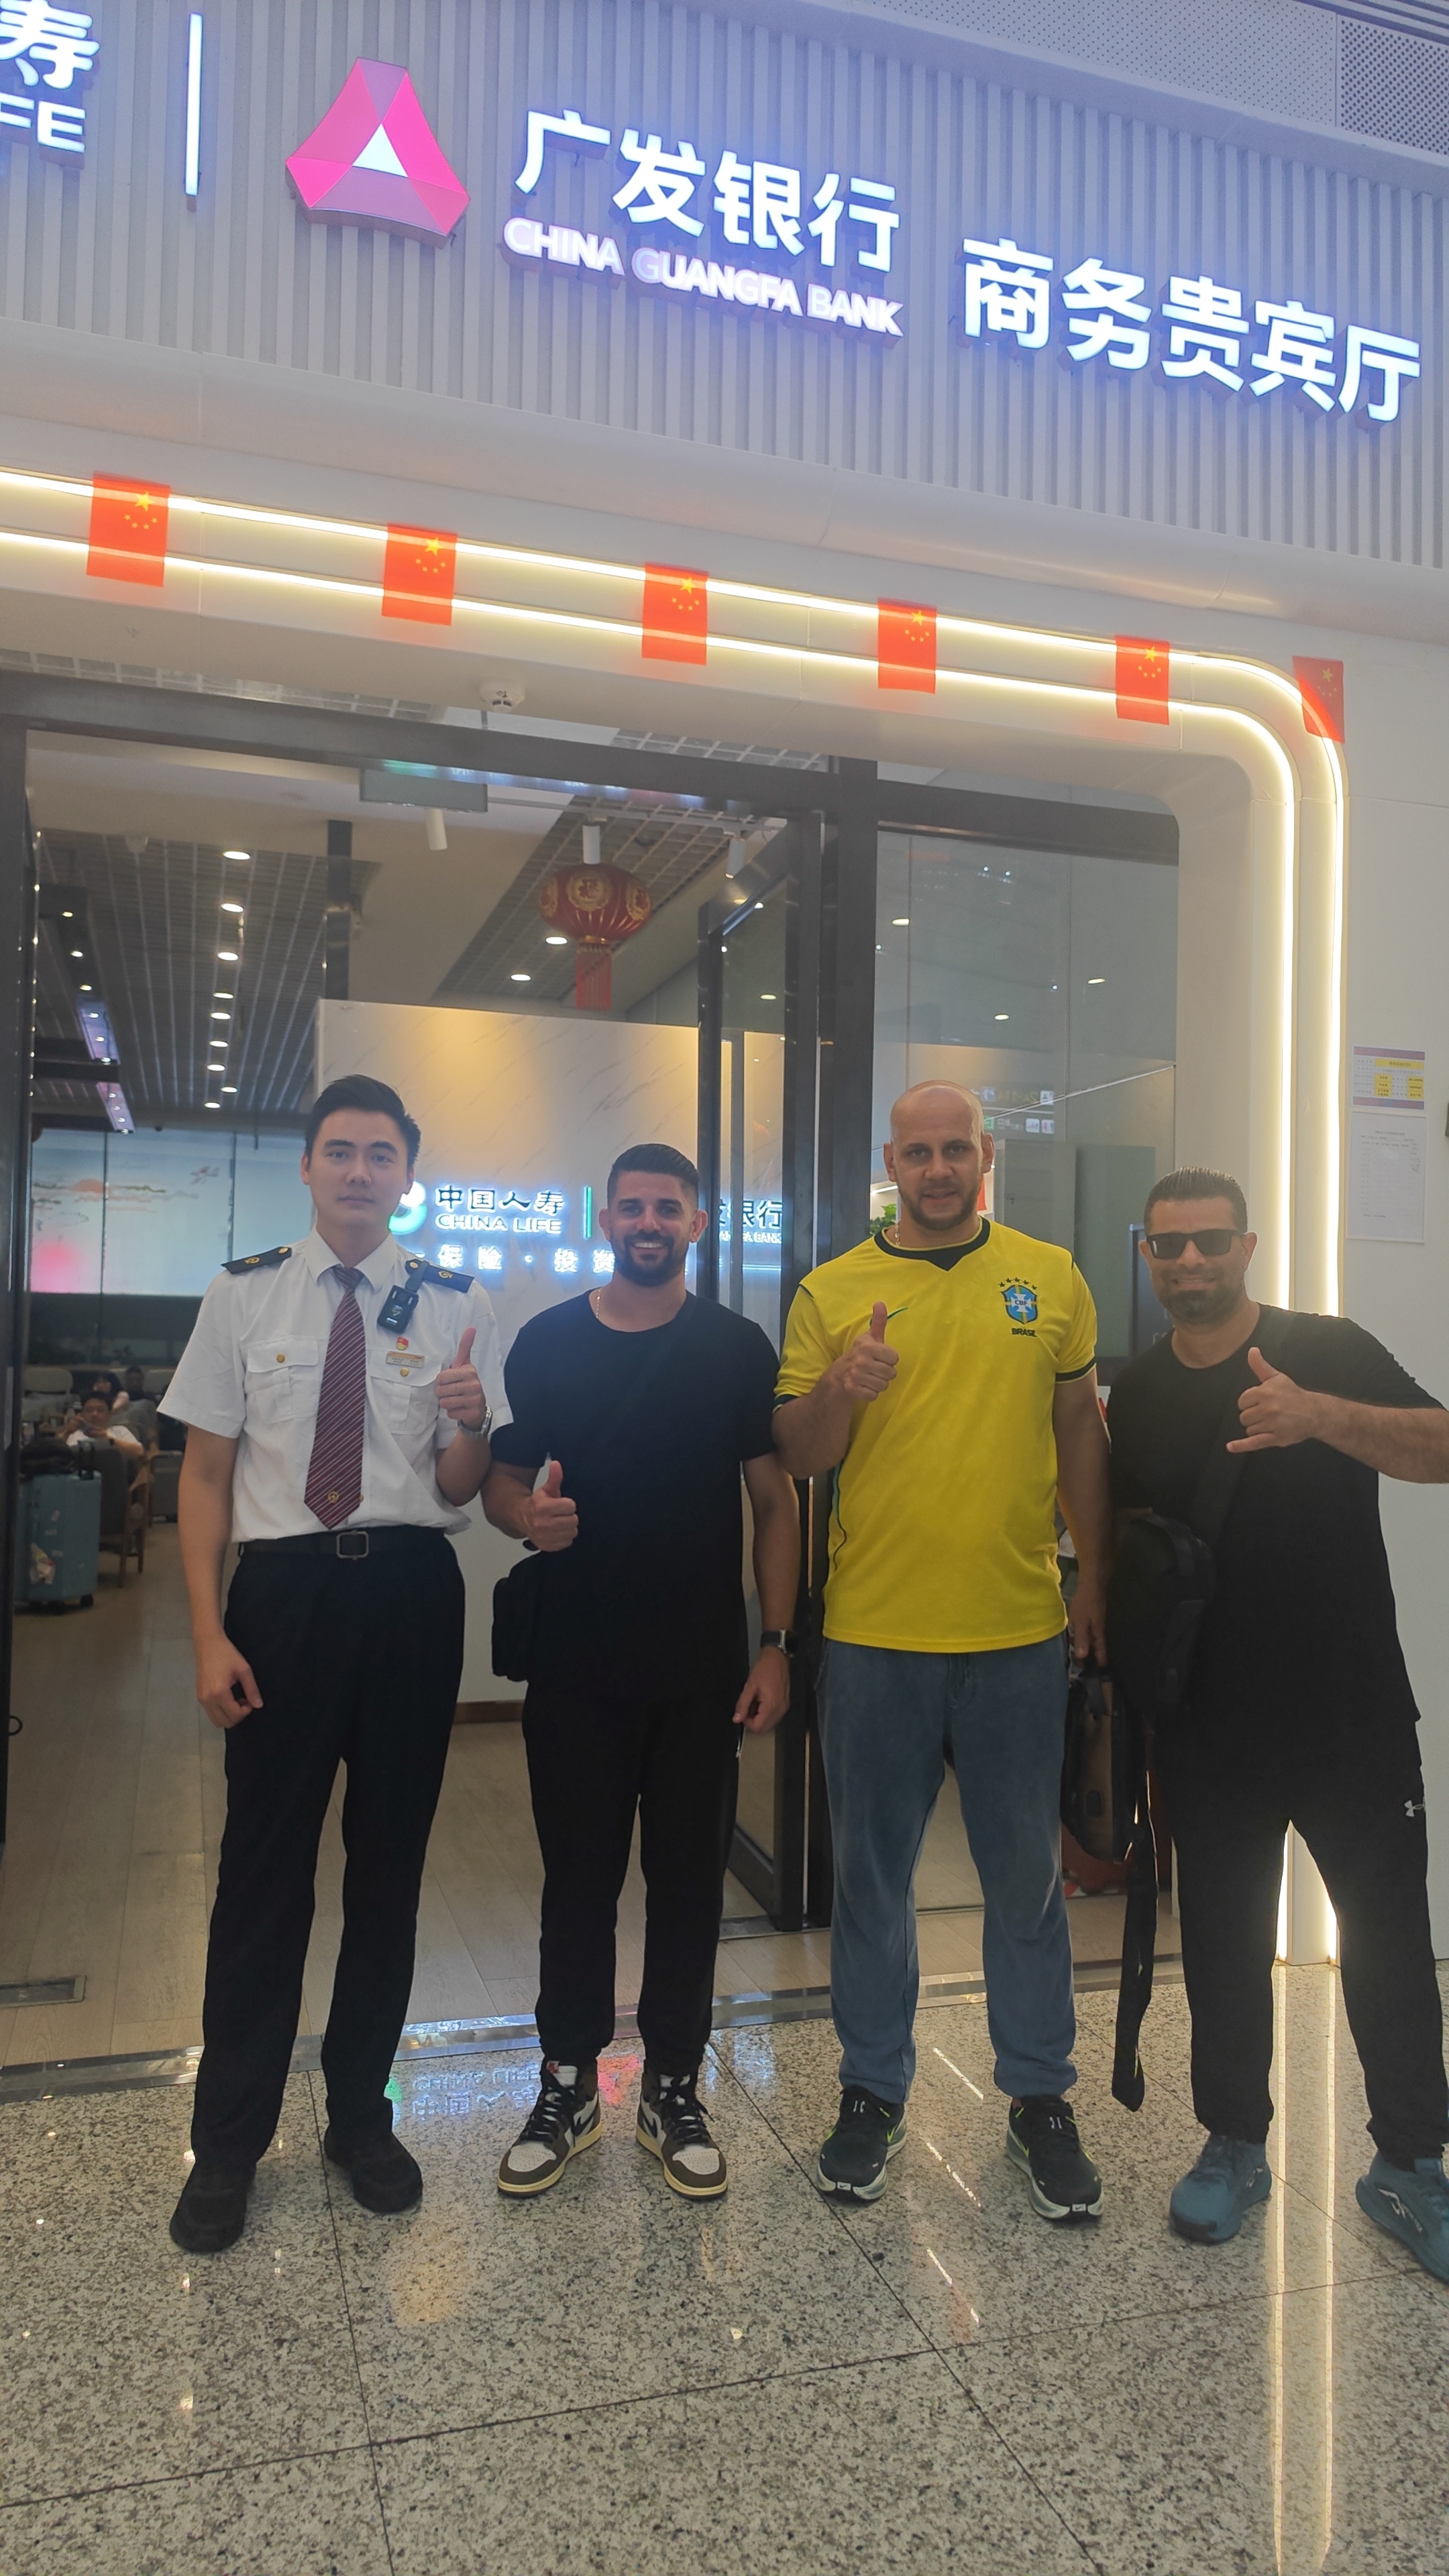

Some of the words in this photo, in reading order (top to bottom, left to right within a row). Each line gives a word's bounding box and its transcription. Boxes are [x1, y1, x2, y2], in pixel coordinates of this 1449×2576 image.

[515, 109, 900, 272] 广发银行
[504, 217, 625, 276] CHINA
[631, 247, 804, 317] GUANGFA
[807, 282, 904, 337] BANK
[962, 237, 1421, 423] 商务贵宾厅
[436, 1184, 564, 1216] 中国人寿
[436, 1214, 508, 1232] CHINA
[513, 1218, 561, 1234] LIFE
[1012, 1328, 1037, 1337] BRASIL
